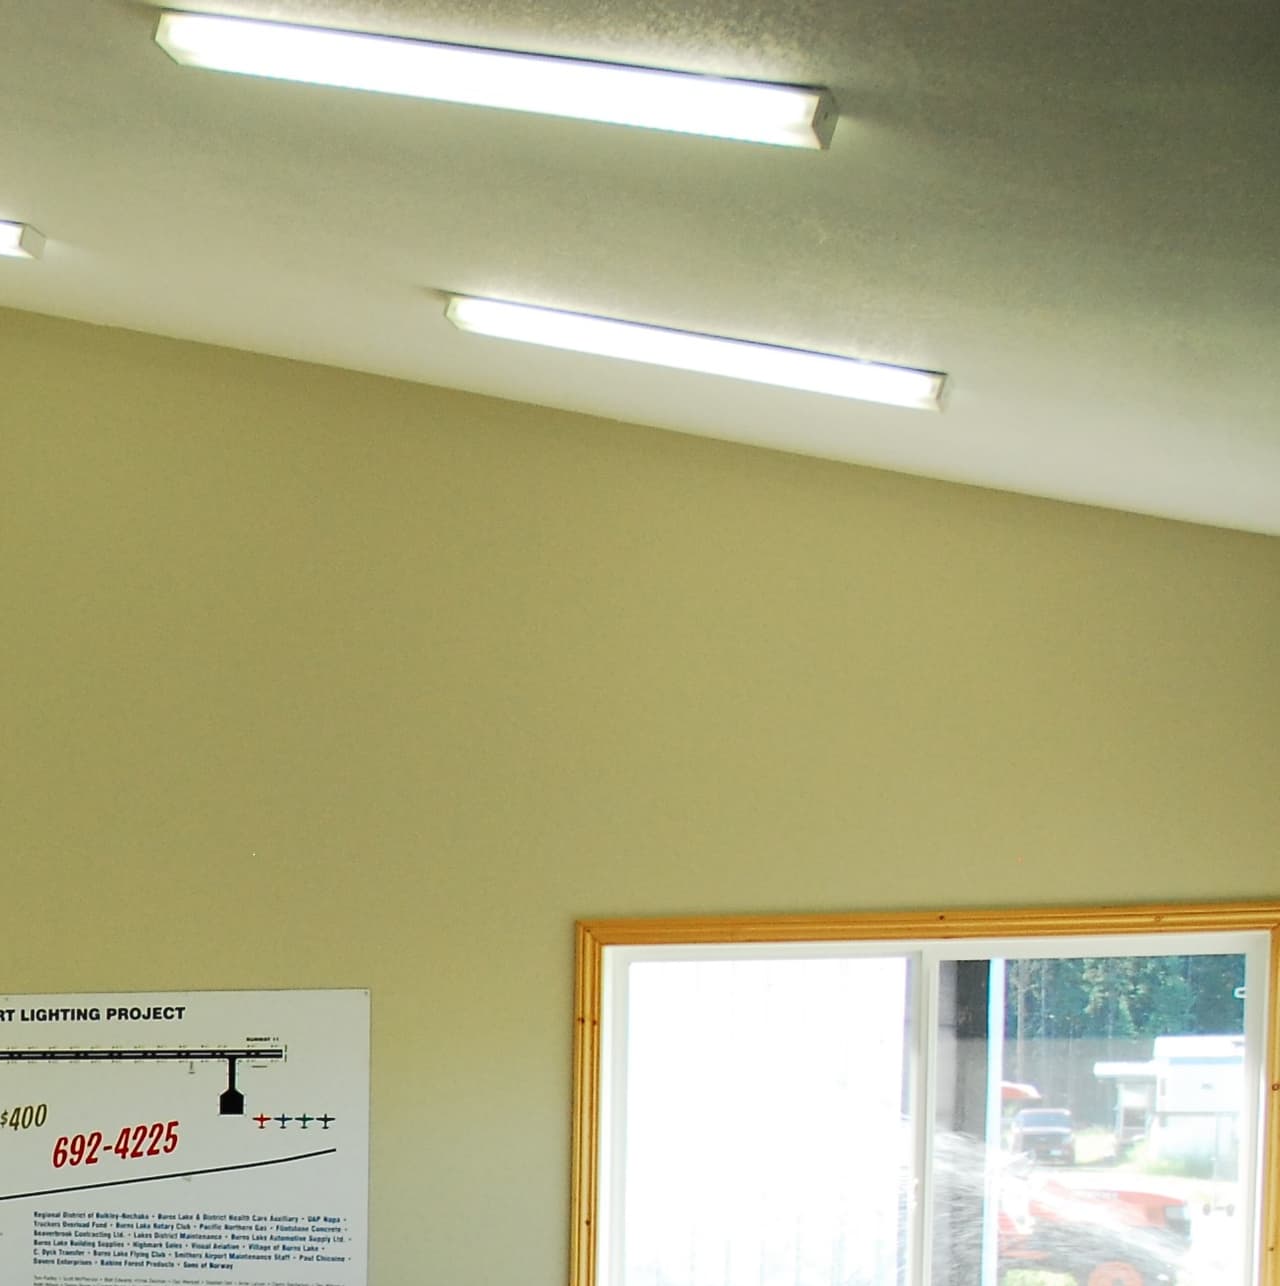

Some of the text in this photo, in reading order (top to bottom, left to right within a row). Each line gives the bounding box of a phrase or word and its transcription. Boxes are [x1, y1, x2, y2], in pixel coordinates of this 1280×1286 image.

[20, 1008, 101, 1022] LIGHTING
[106, 1006, 186, 1020] PROJECT
[0, 1104, 48, 1132] $400
[53, 1120, 180, 1168] 692-4225
